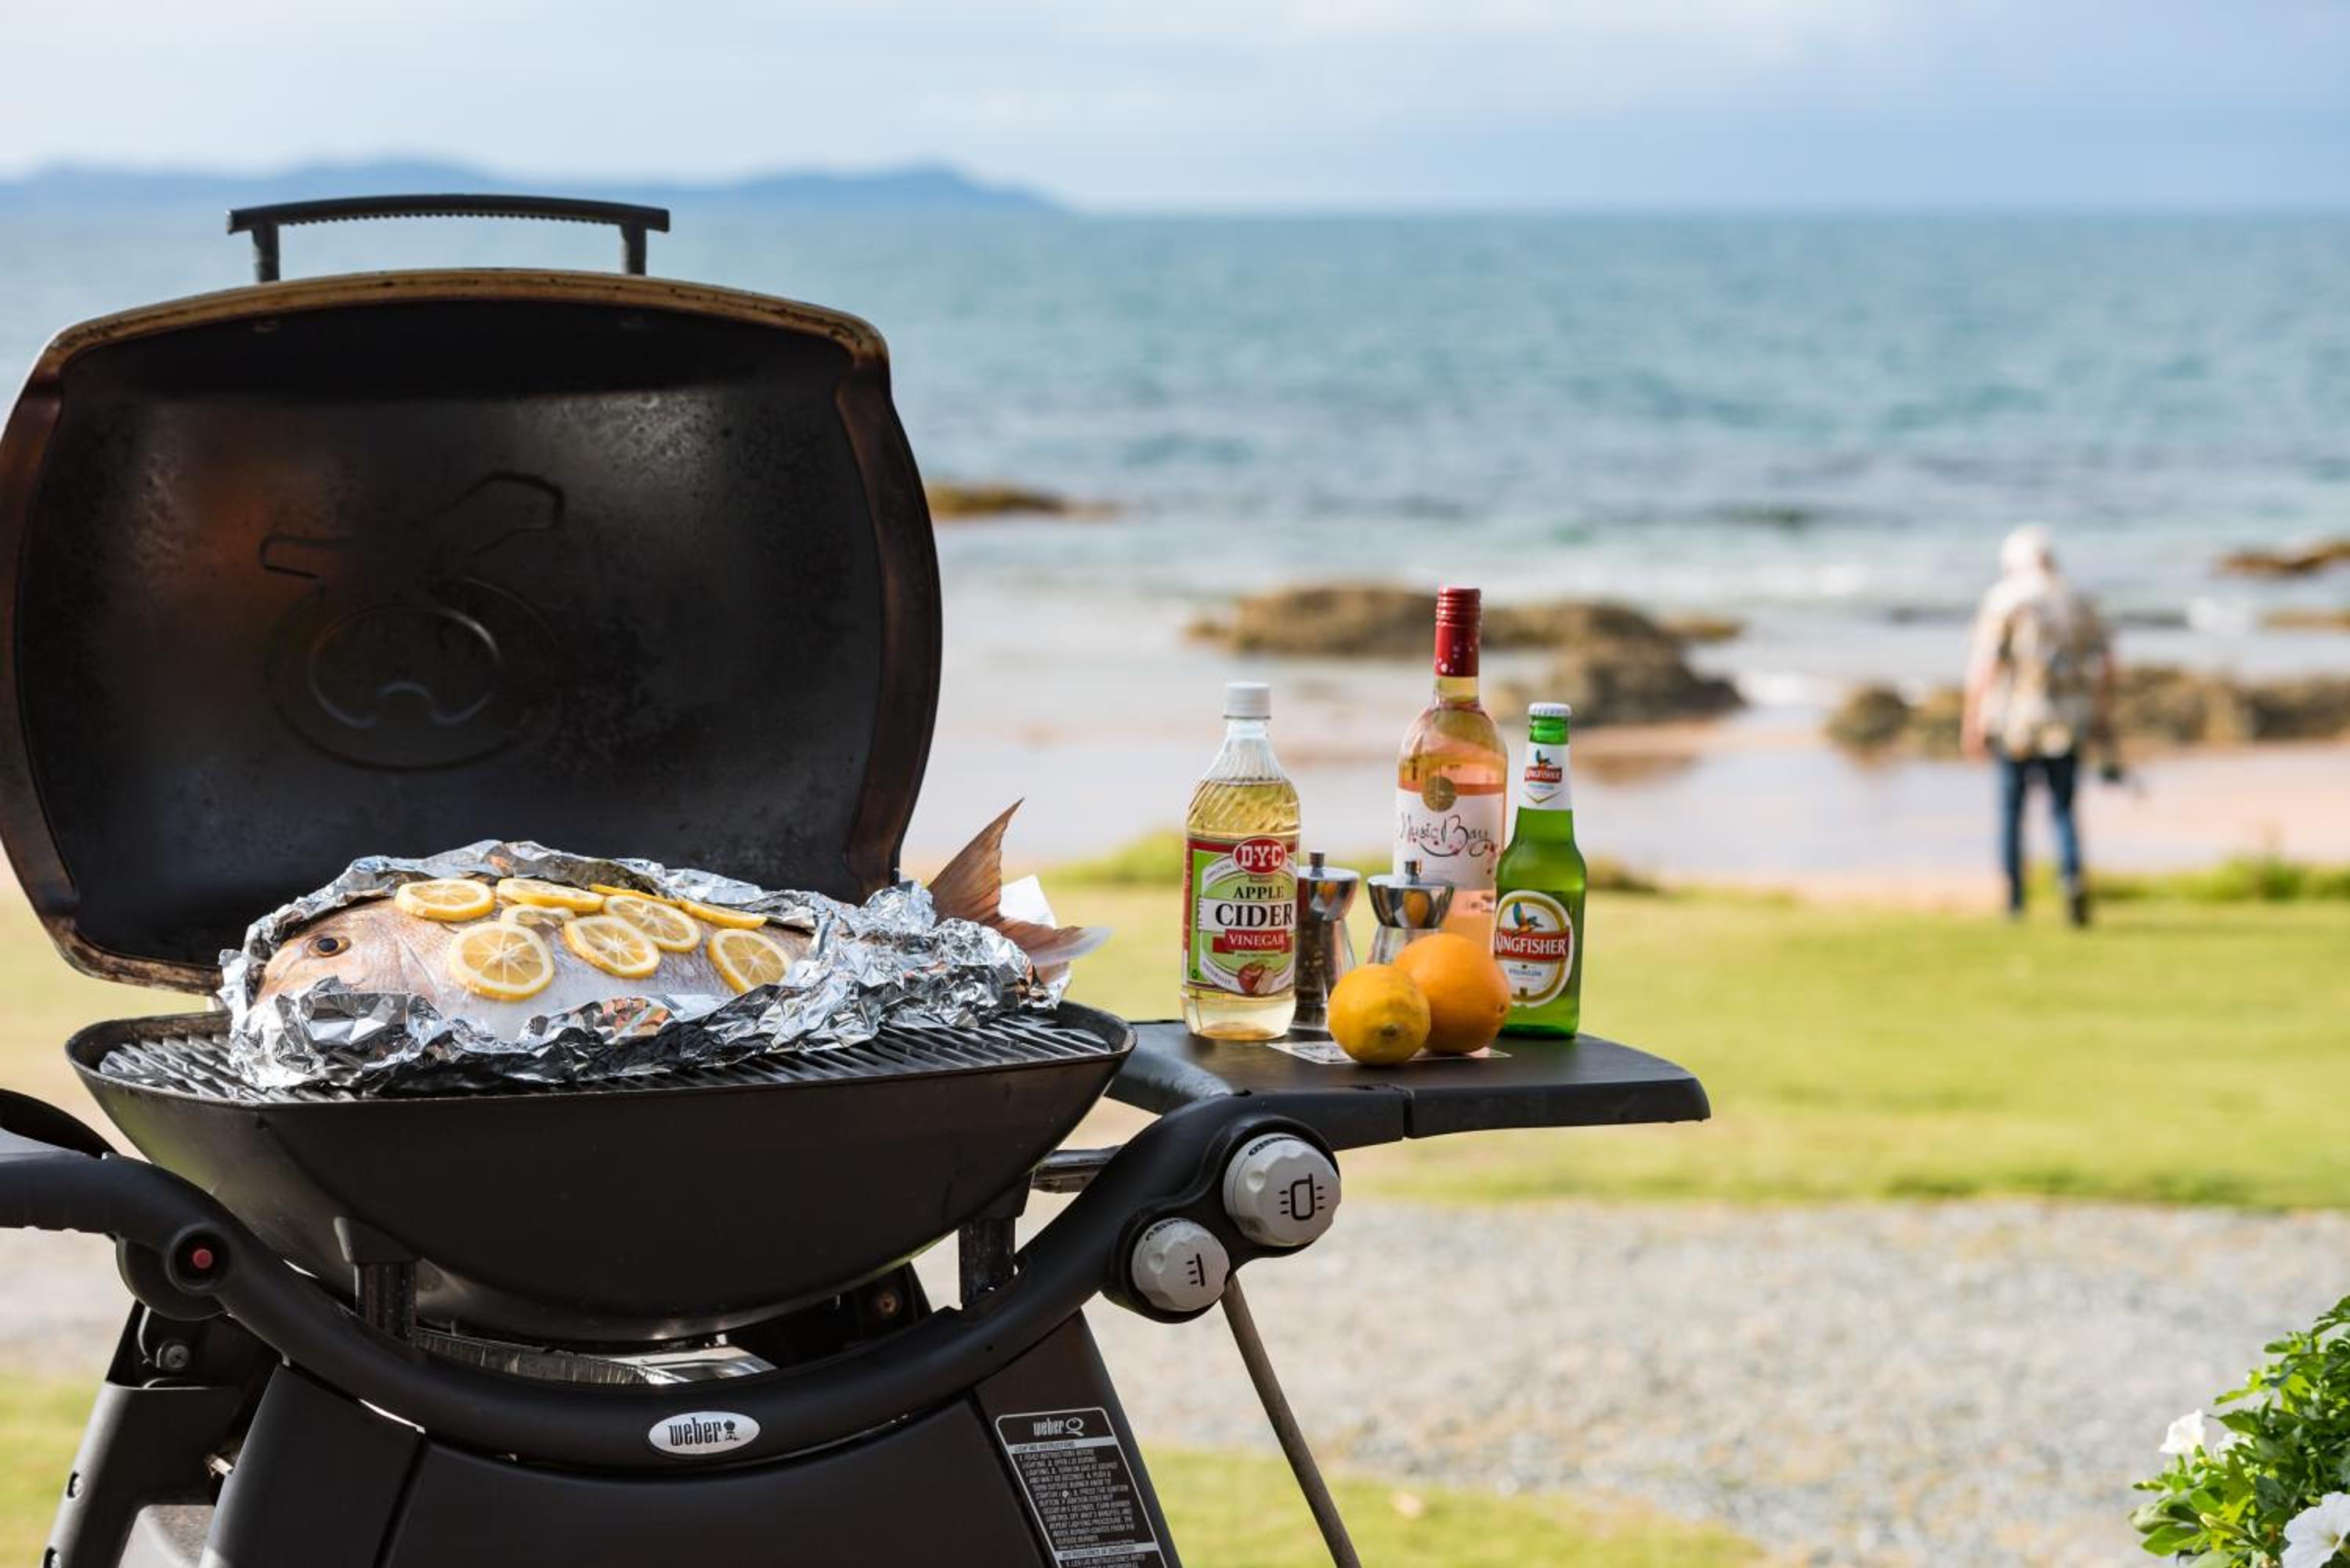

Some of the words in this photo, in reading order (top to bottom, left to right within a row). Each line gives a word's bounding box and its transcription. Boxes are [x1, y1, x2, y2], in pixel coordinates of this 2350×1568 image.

[1234, 886, 1284, 899] APPLE
[1215, 903, 1292, 927] CIDER
[668, 1417, 722, 1447] weber
[1033, 1418, 1065, 1436] weber
